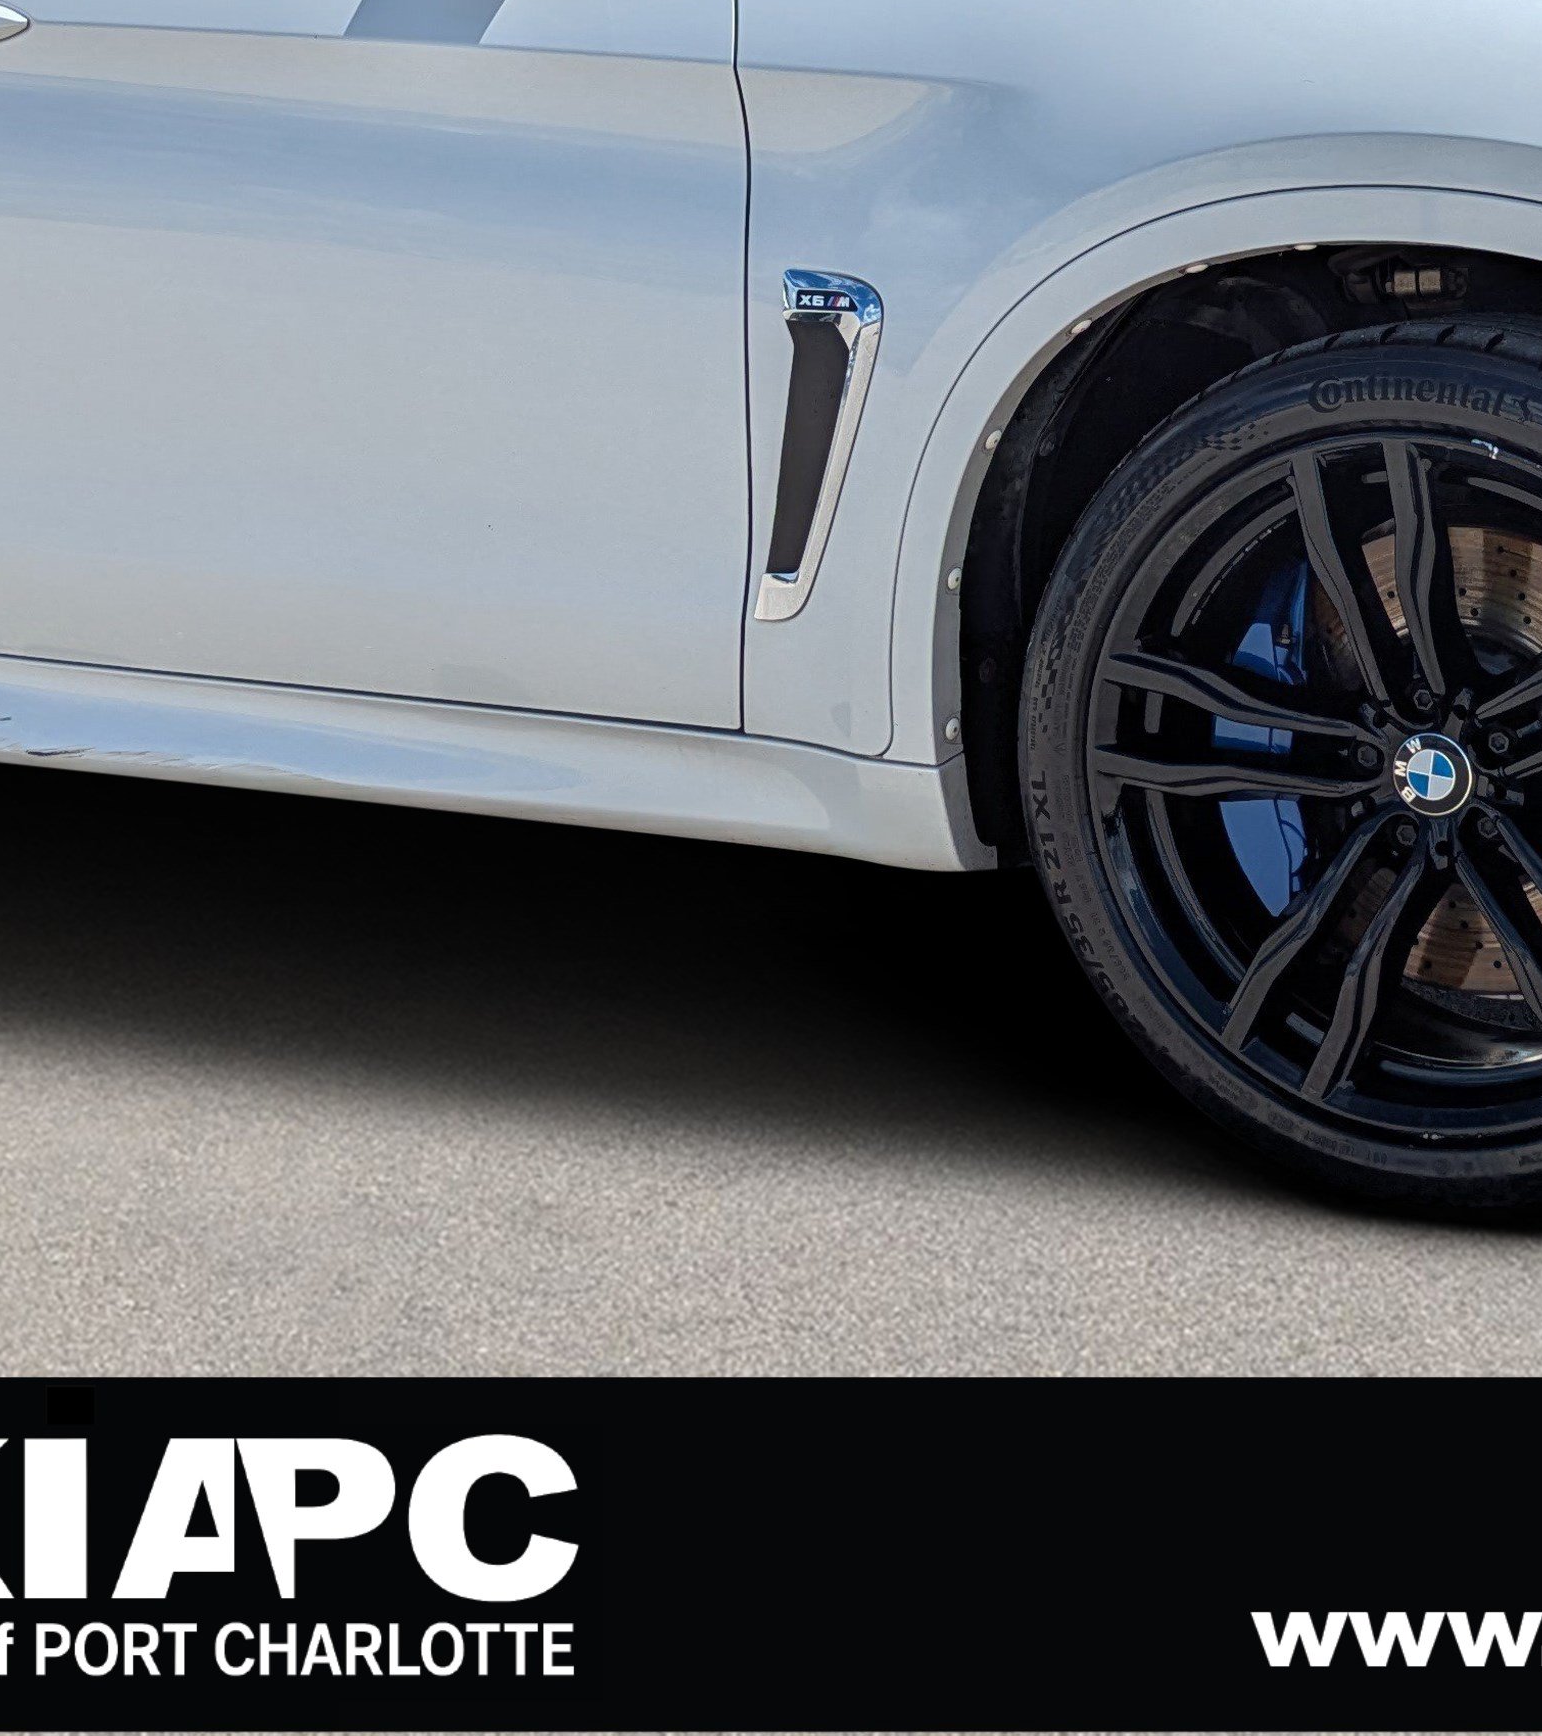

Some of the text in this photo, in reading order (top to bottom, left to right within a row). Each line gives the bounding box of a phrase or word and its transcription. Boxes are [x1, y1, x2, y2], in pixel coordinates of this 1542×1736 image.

[798, 294, 825, 307] X6
[1308, 374, 1510, 417] Continental
[1393, 737, 1422, 803] BMW
[1030, 769, 1052, 821] XL
[1039, 832, 1061, 872] 21
[1052, 879, 1072, 905] R
